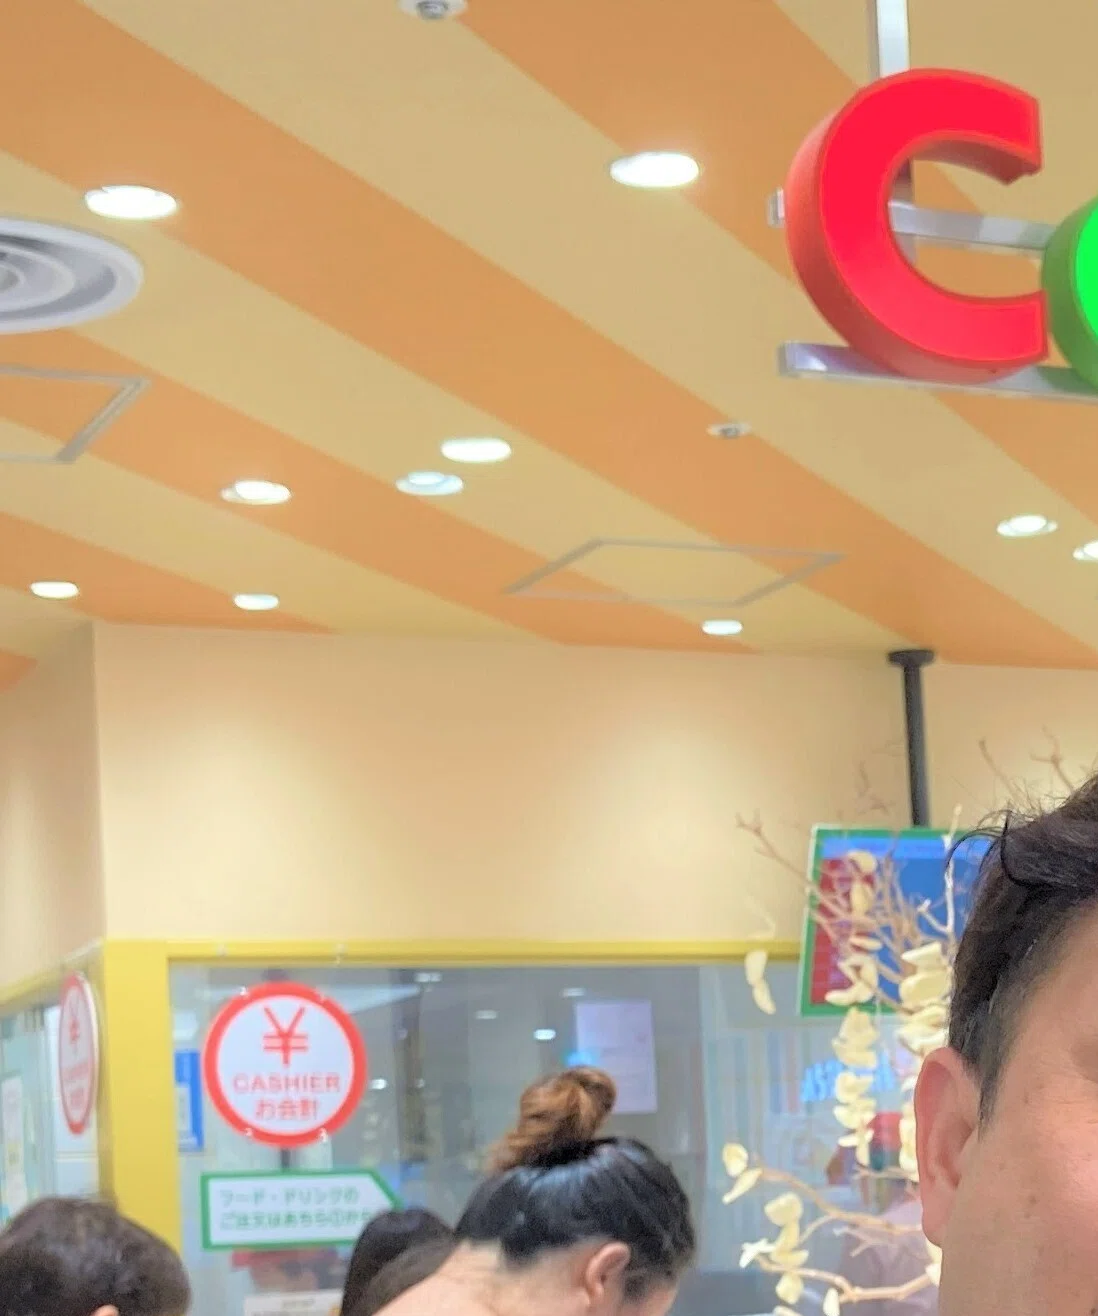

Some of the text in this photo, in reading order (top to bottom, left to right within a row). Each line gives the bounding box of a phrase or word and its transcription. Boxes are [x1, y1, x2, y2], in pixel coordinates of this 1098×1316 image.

[233, 1073, 341, 1093] CASHIER
[256, 1098, 319, 1121] お会計
